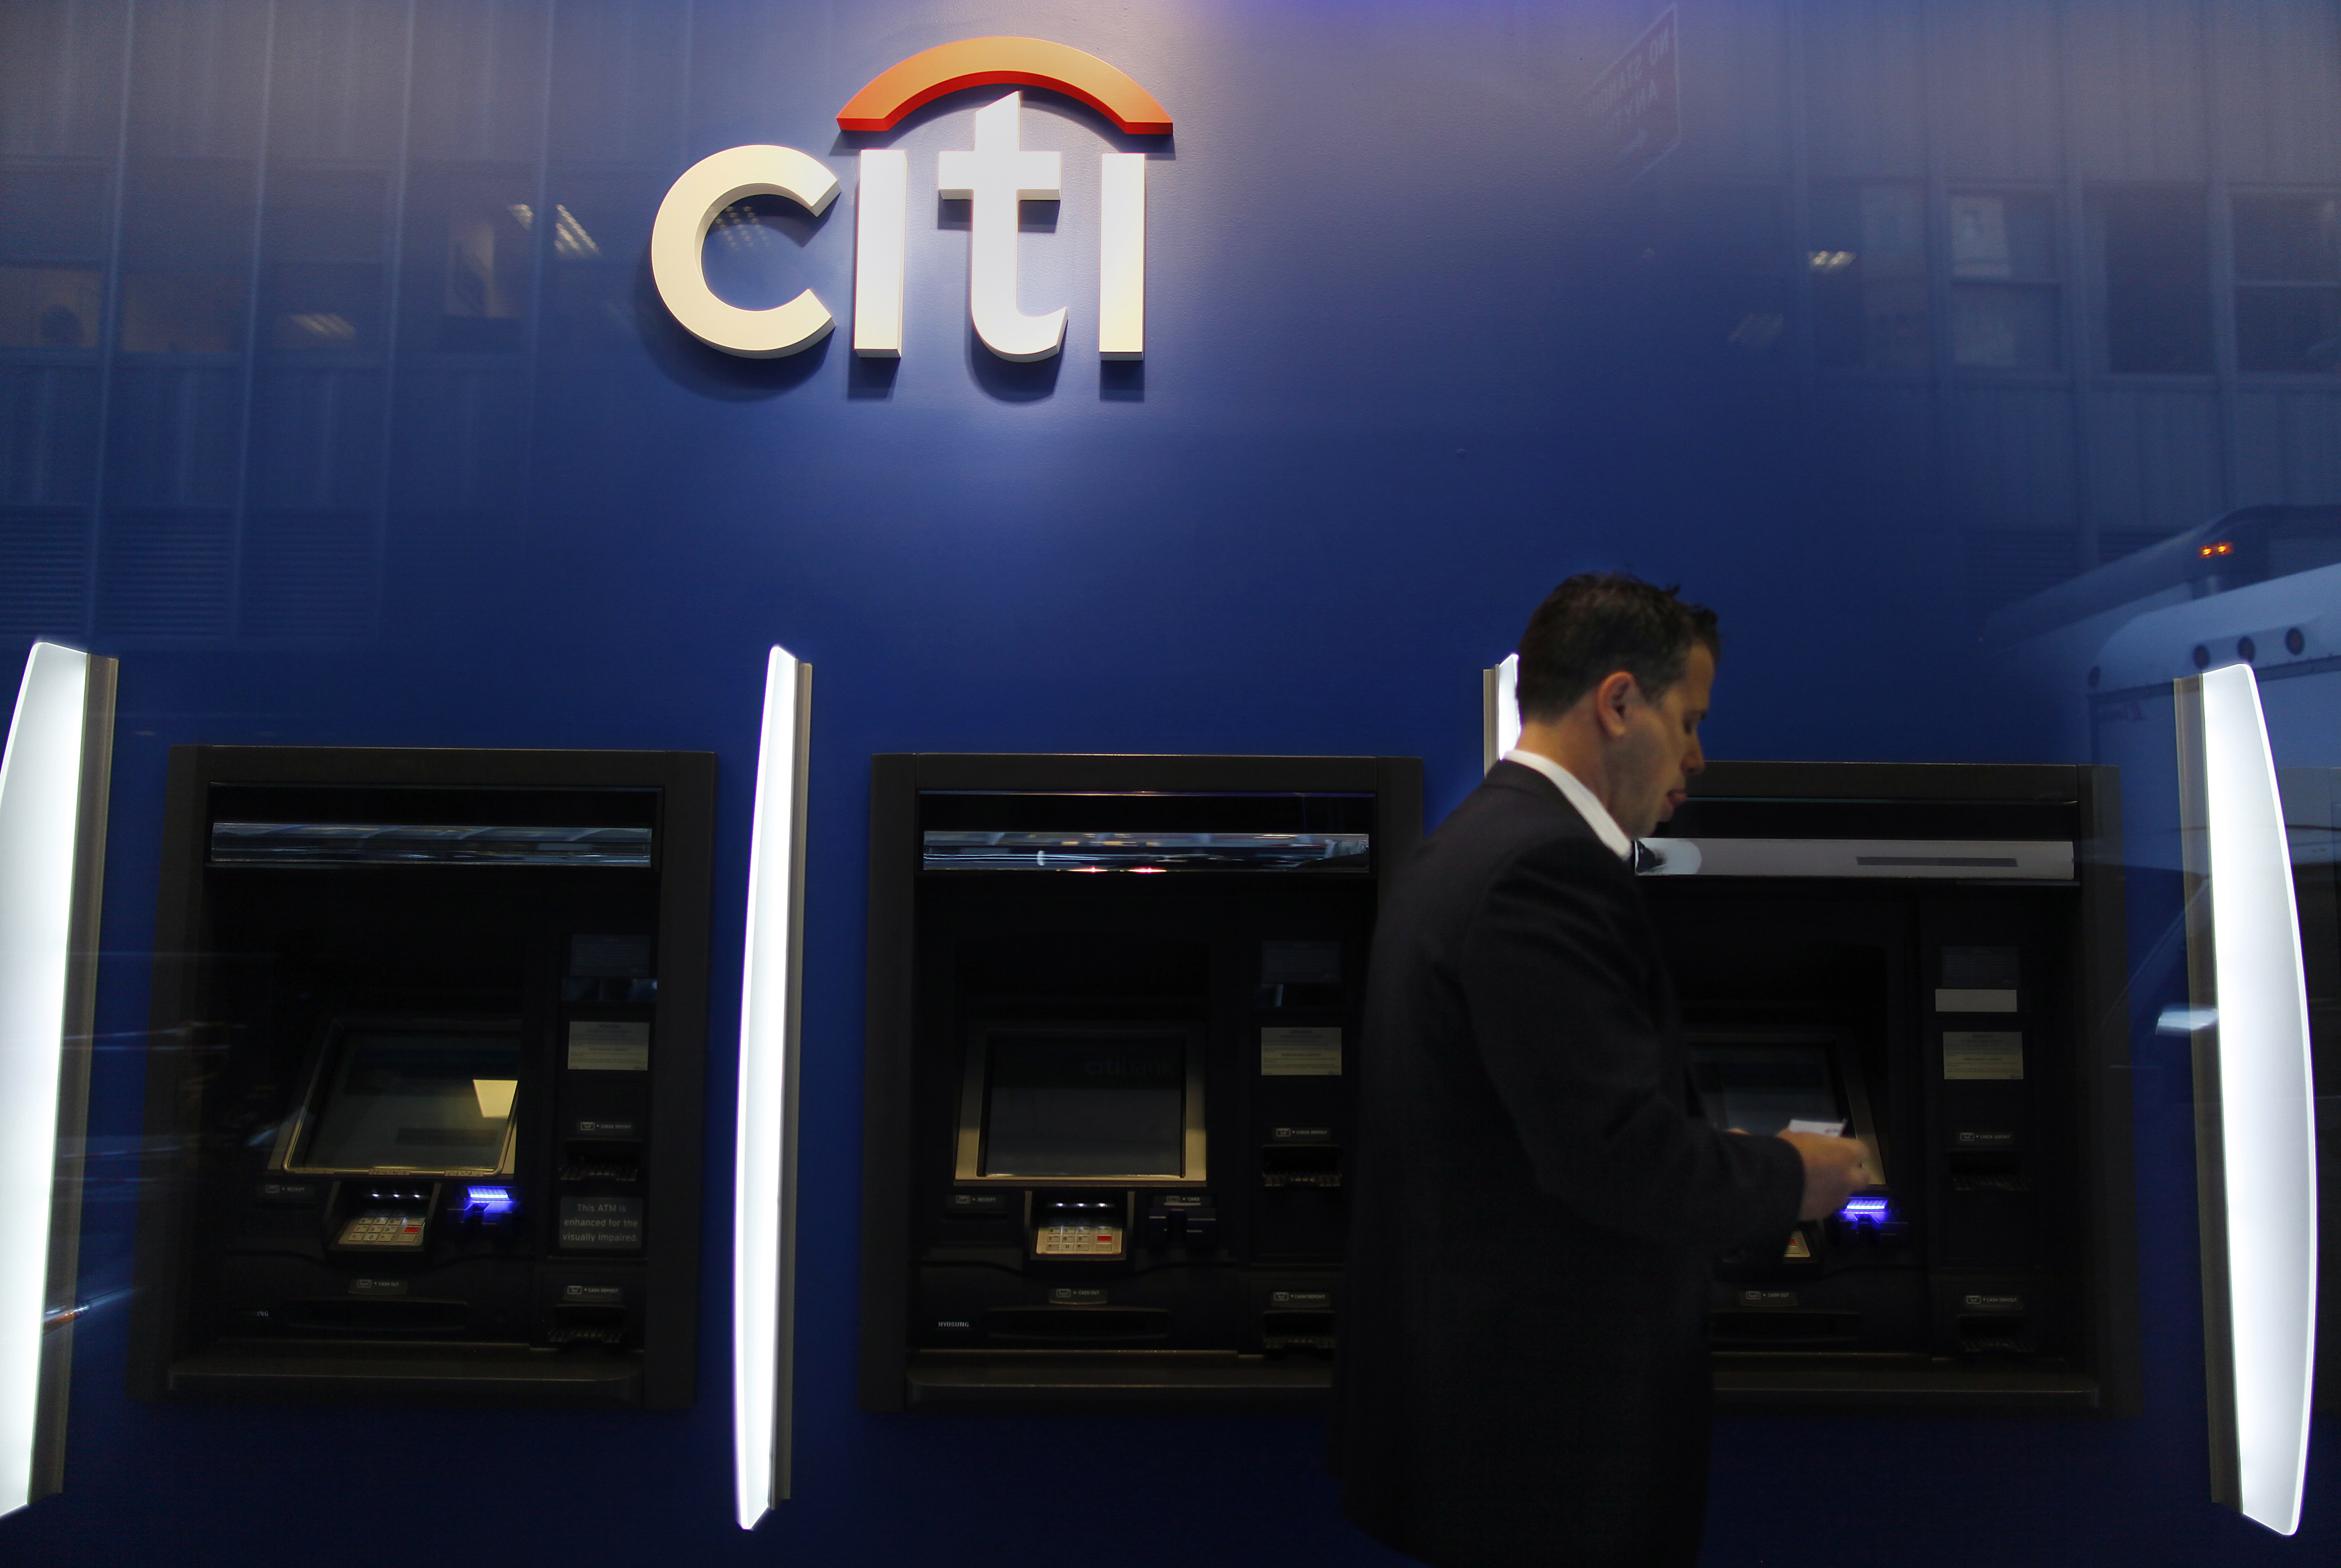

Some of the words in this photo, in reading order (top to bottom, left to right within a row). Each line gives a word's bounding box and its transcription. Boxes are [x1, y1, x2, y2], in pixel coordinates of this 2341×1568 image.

[651, 91, 1146, 362] citi
[1085, 1056, 1173, 1076] citibank
[577, 1204, 595, 1212] This
[597, 1204, 617, 1212] ATM
[619, 1204, 627, 1212] is
[564, 1218, 606, 1227] enhanced
[609, 1219, 621, 1227] for
[623, 1220, 638, 1228] the
[563, 1232, 596, 1242] visually
[598, 1233, 639, 1242] impaired.
